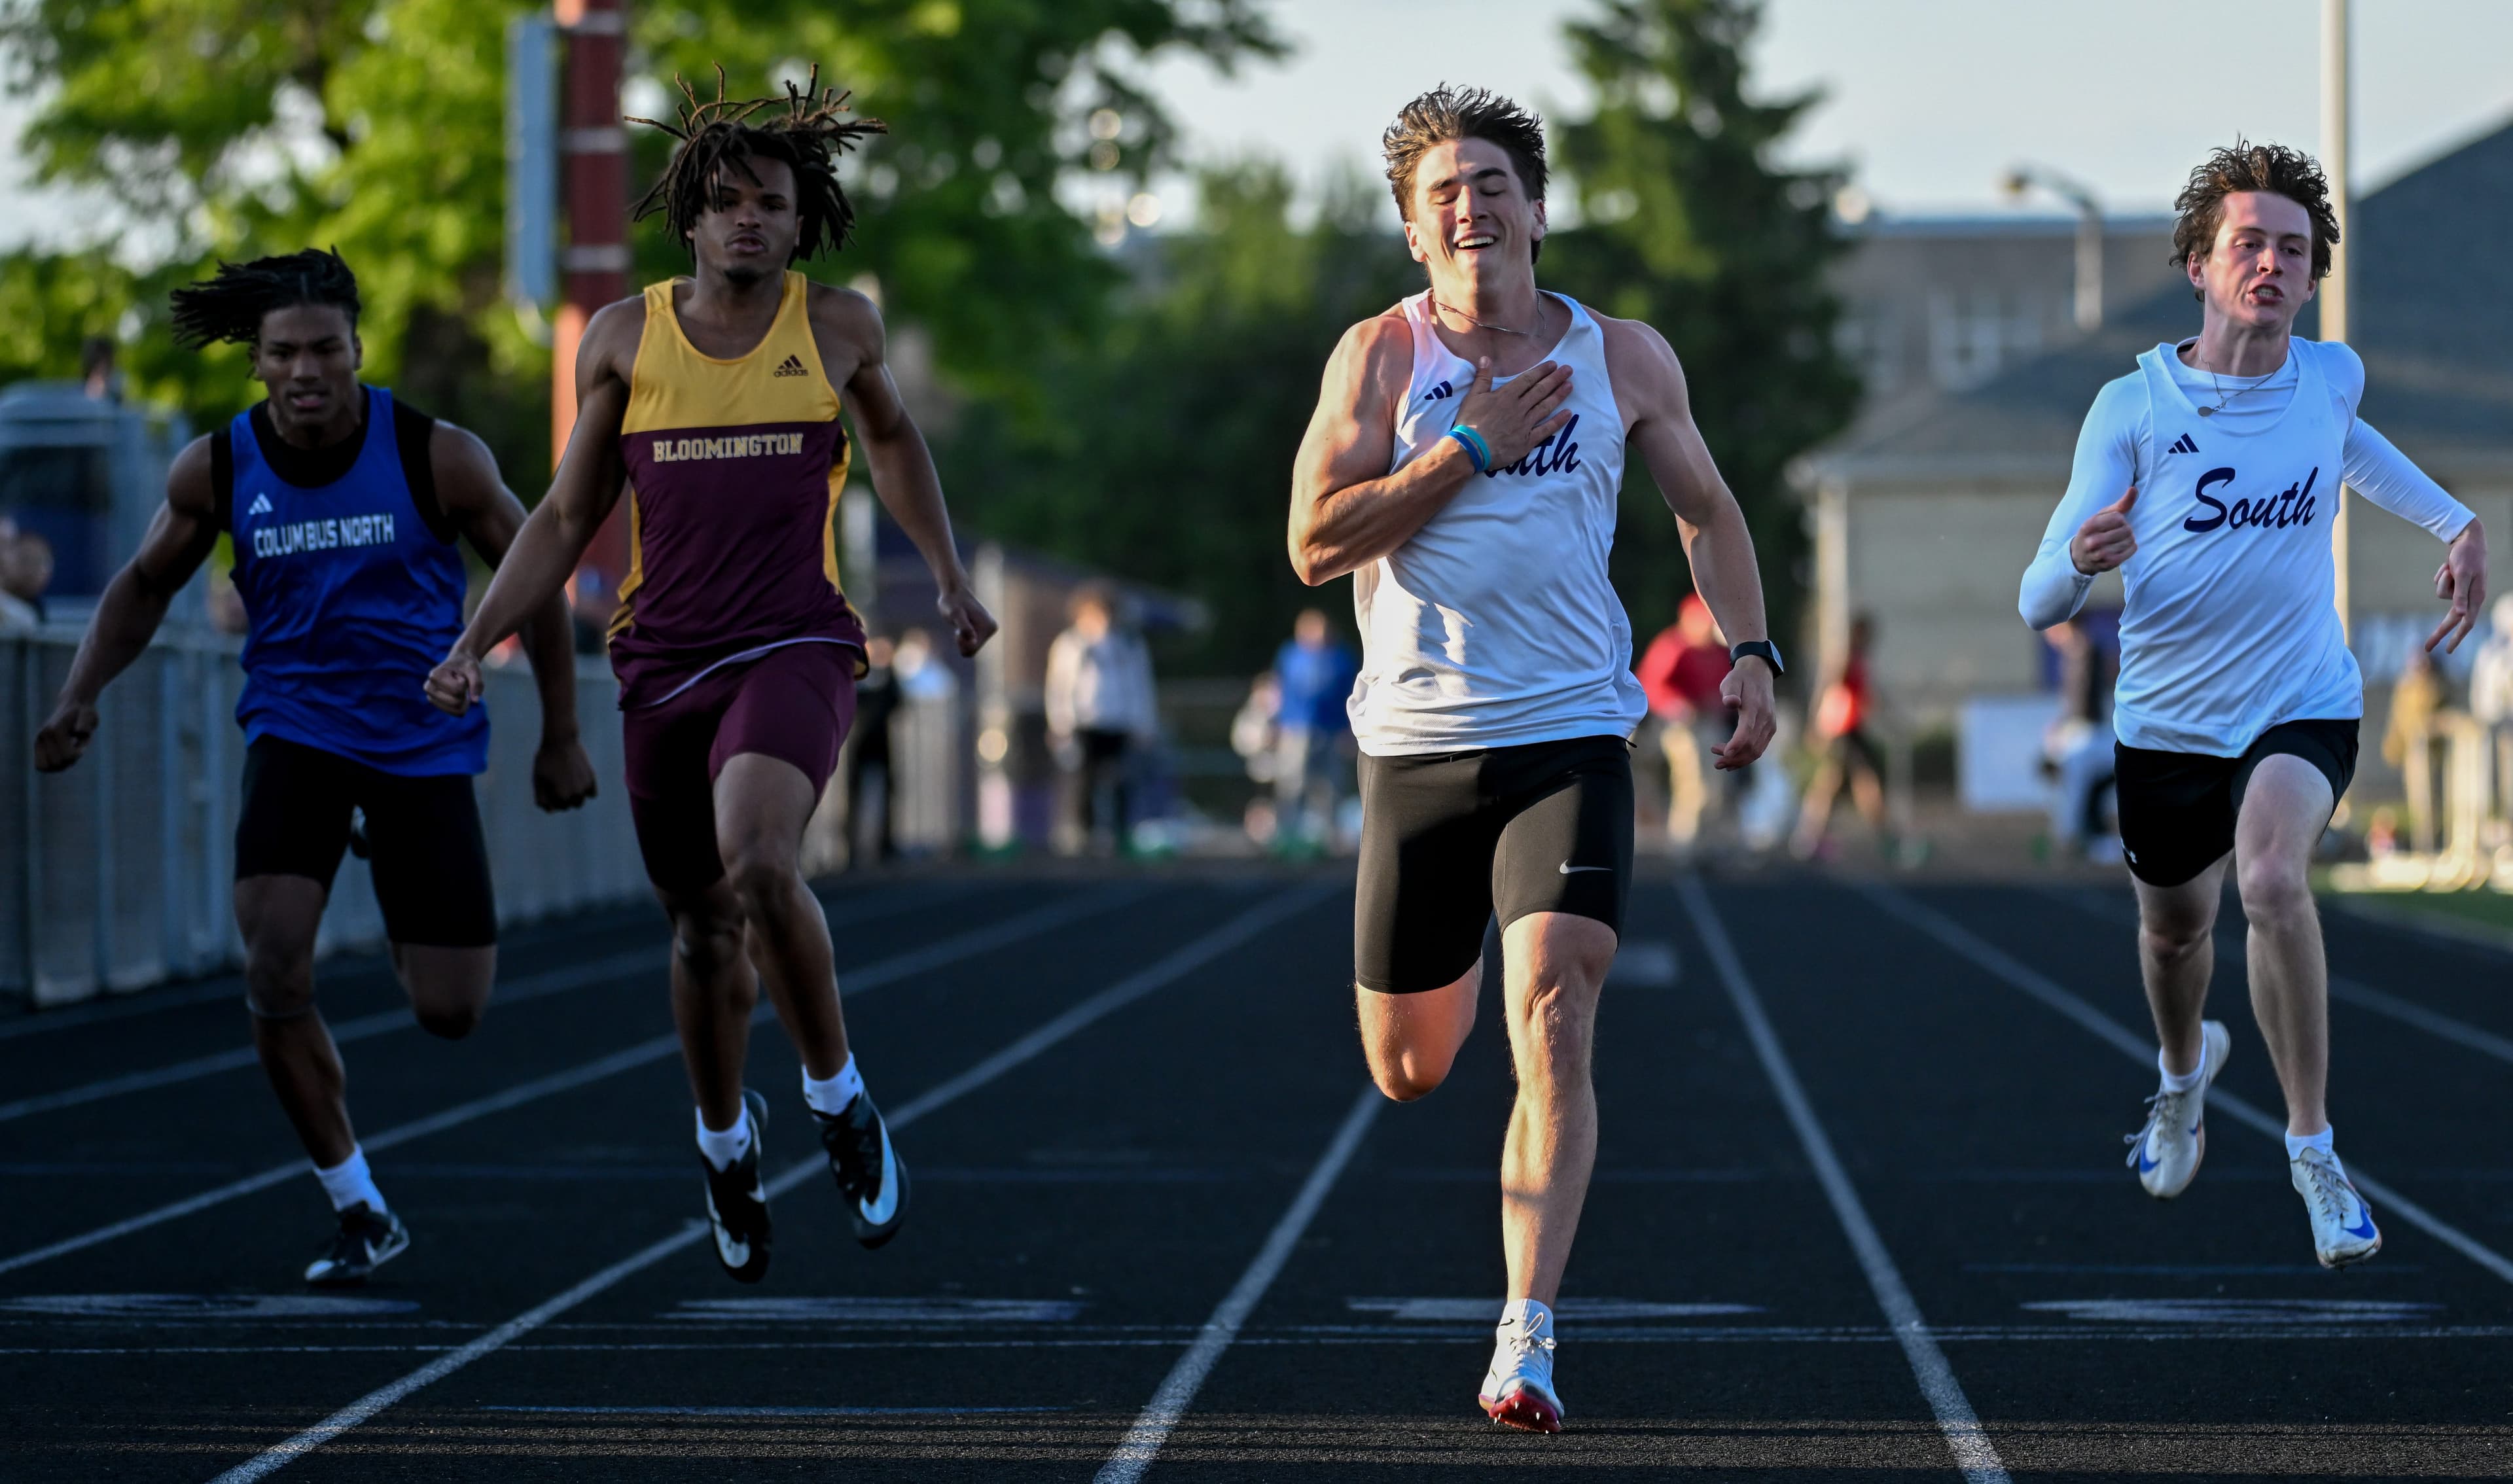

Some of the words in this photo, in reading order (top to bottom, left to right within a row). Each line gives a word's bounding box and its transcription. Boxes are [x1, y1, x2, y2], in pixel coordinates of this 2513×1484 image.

[774, 367, 809, 378] adidas
[652, 433, 804, 463] BLOOMINGTON
[2184, 467, 2319, 533] South
[253, 518, 338, 557] COLUMBUS
[340, 513, 395, 547] NORTH
